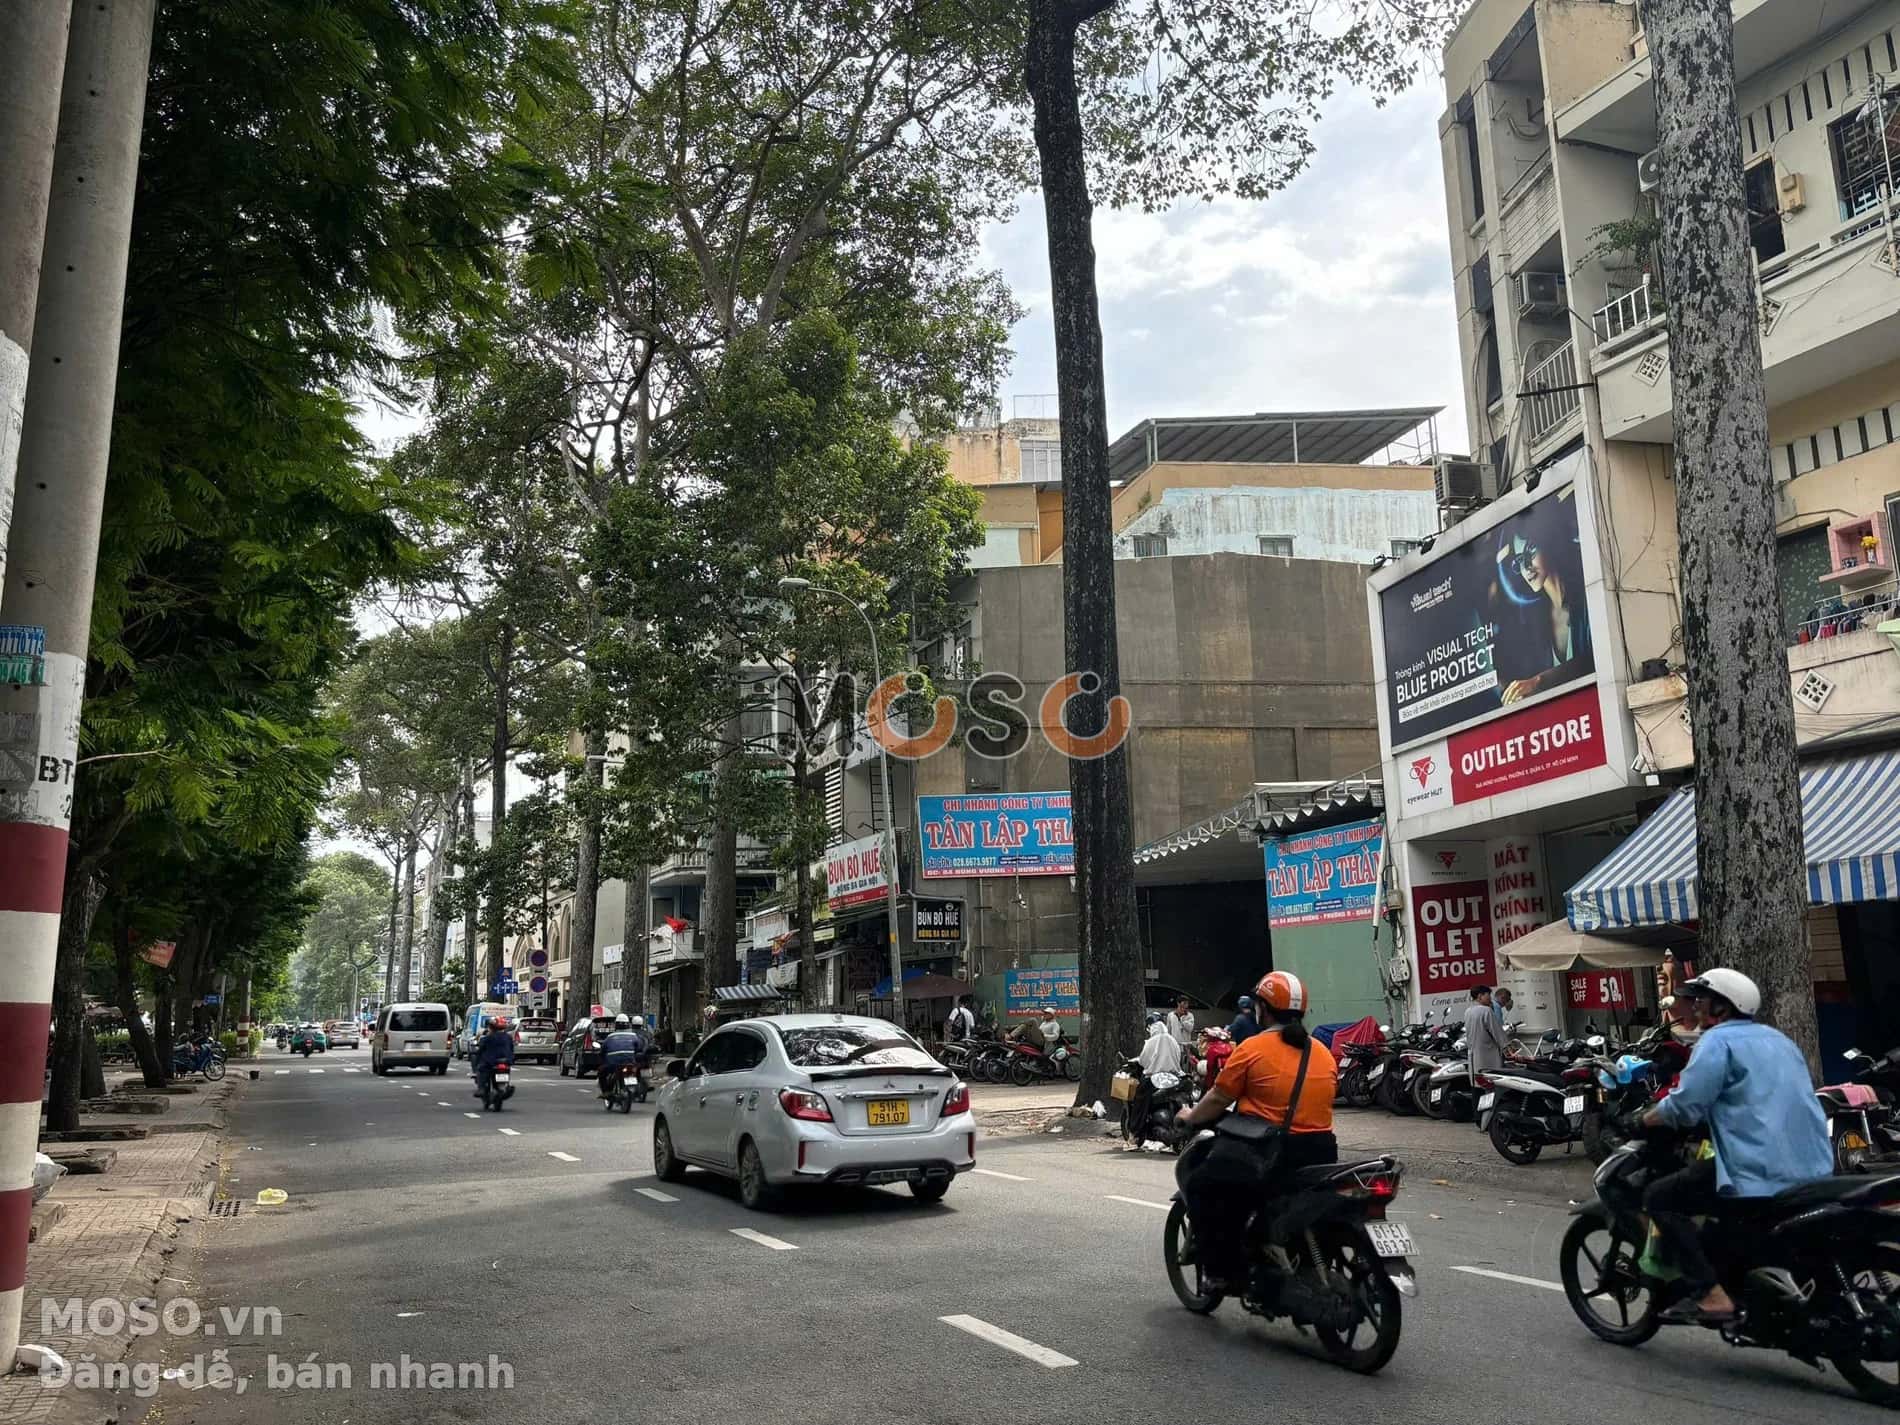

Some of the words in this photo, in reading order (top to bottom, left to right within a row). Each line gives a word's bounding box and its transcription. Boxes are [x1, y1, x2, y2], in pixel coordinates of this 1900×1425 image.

[1426, 637, 1463, 665] VISUAL
[1464, 621, 1494, 649] TECH
[1396, 673, 1428, 704] BLUE
[1430, 643, 1495, 691] PROTECT
[1461, 736, 1525, 776] OUTLET
[1530, 714, 1592, 756] STORE
[964, 797, 998, 811] NHÁNH
[1001, 796, 1028, 811] CÔNG
[924, 813, 975, 849] TÂN
[981, 812, 1028, 854] LẬP
[828, 852, 845, 885] BÚN
[847, 848, 859, 880] BÒ
[861, 836, 880, 876] HUẾ
[1494, 843, 1529, 869] MẮT
[1267, 858, 1298, 897] TÂN
[1301, 852, 1333, 899] LẬP
[1495, 871, 1536, 895] KÍNH
[917, 908, 932, 926] BÚN
[933, 908, 943, 926] BÒ
[1420, 895, 1483, 927] OUT
[1494, 896, 1544, 920] CHÍNH
[1426, 926, 1483, 958] LET
[1428, 958, 1486, 980] STORE
[1571, 977, 1587, 990] SALE
[1574, 990, 1586, 1003] OFF
[879, 1102, 898, 1112] 51H
